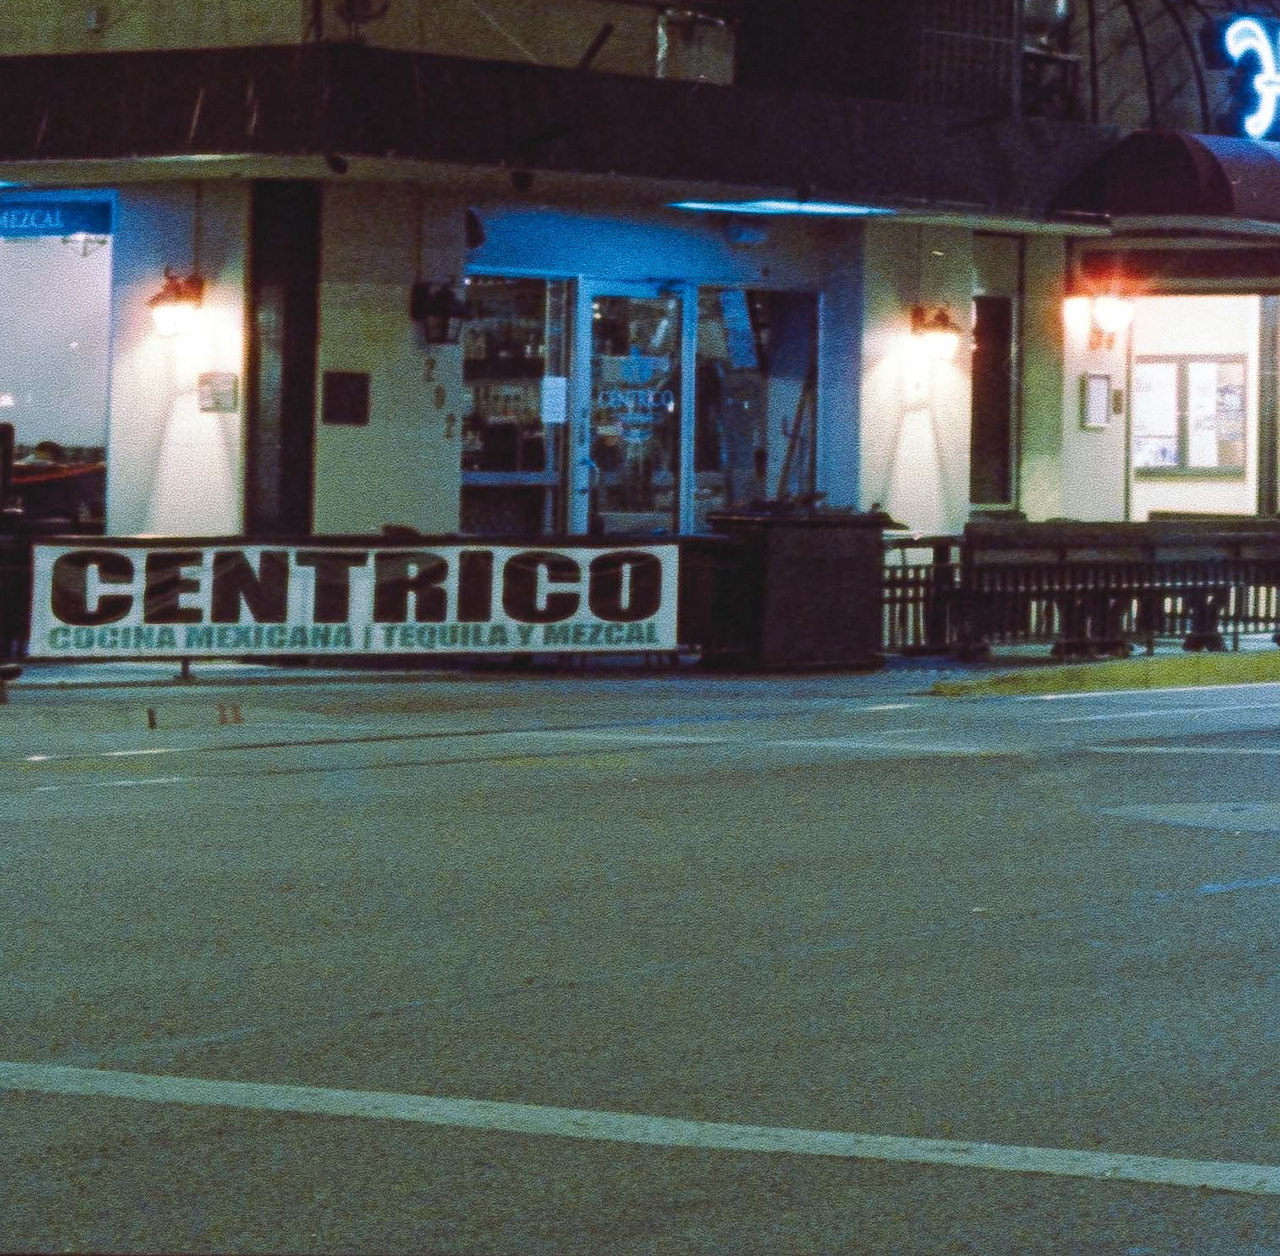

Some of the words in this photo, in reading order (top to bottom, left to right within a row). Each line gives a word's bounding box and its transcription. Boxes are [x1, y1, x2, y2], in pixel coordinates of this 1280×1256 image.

[51, 549, 662, 626] CENTRICO
[49, 625, 175, 650] COCINA
[185, 624, 350, 649] MEXICANA
[381, 623, 510, 649] TEQUILA
[513, 623, 538, 646] Y
[542, 622, 659, 645] MEZCAL
